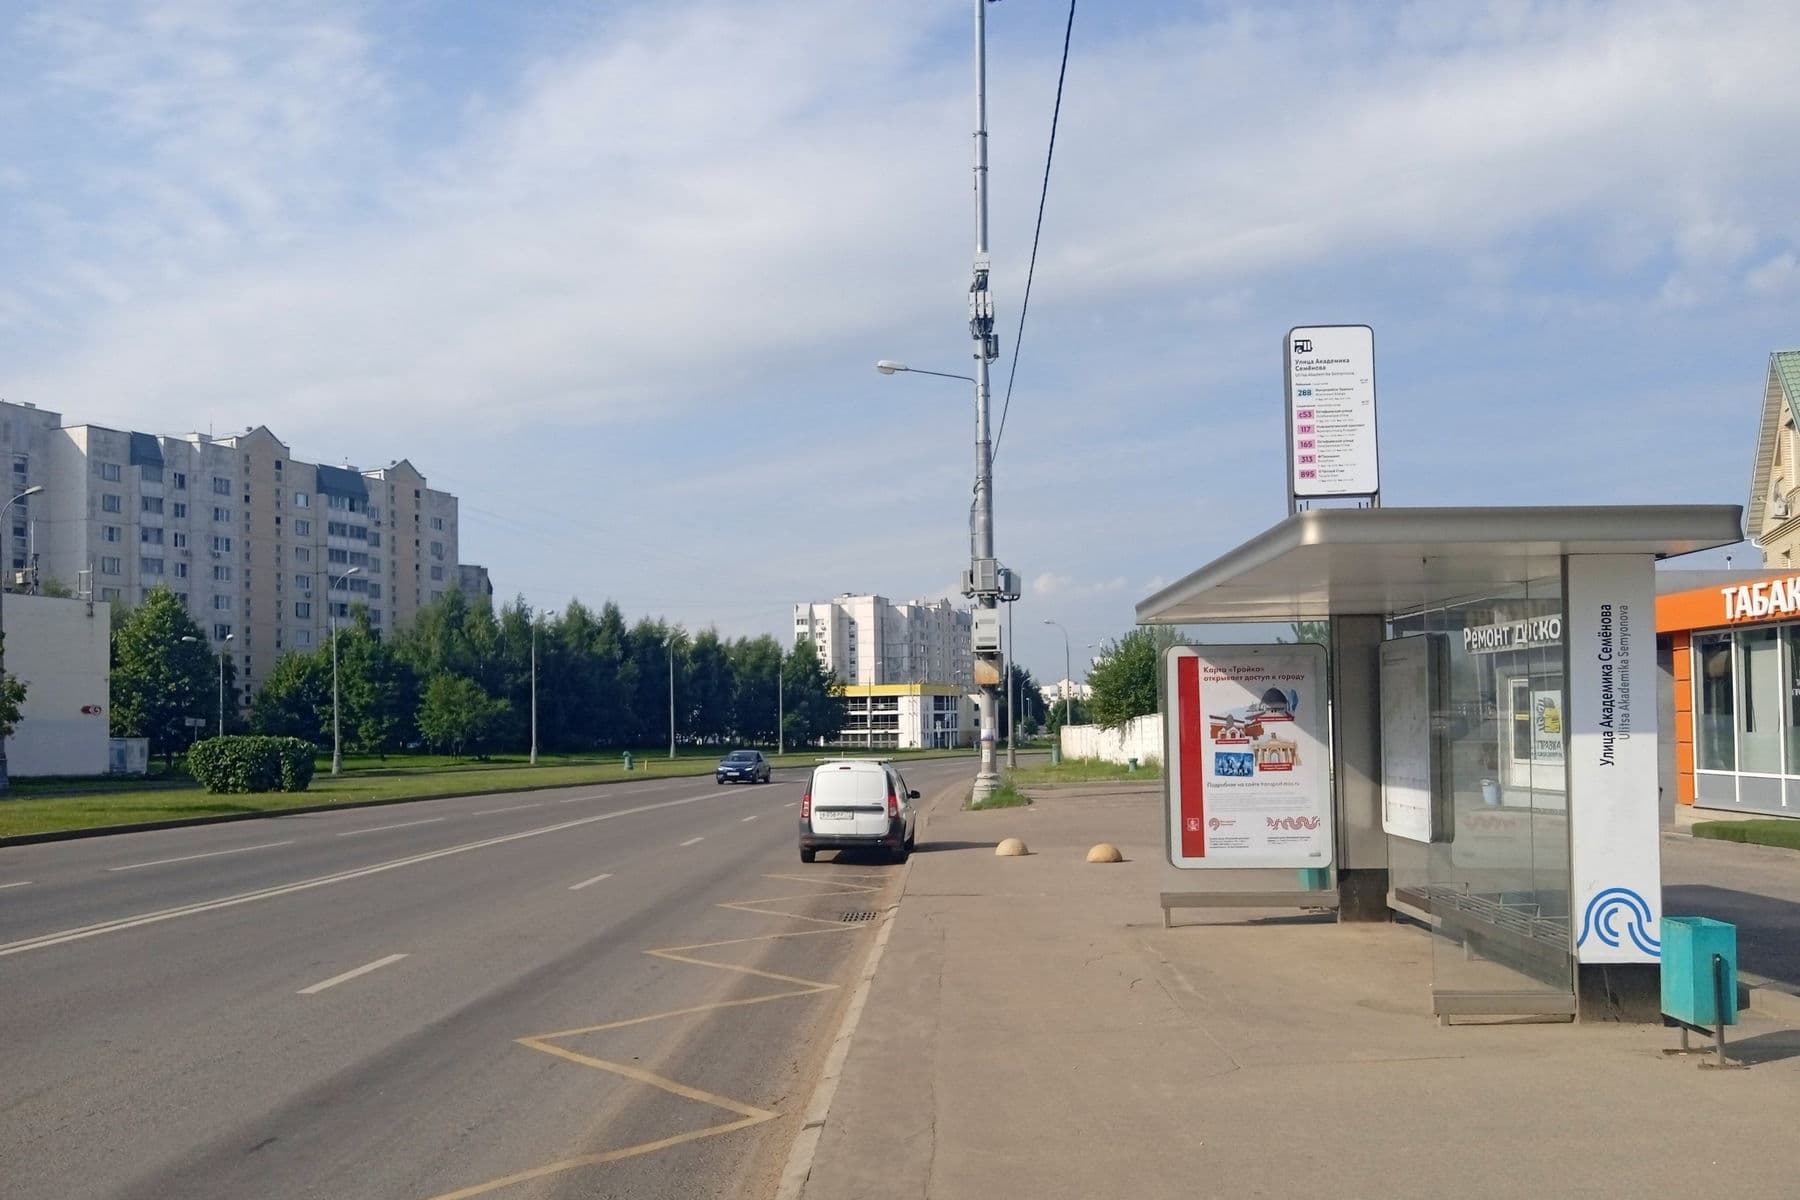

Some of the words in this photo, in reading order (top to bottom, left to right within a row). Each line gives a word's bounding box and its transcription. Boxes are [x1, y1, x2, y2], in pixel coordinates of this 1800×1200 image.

[1297, 389, 1312, 397] 288
[1597, 604, 1613, 662] Семёнова
[1617, 605, 1631, 658] Semyonova
[1203, 666, 1227, 675] Карта
[1203, 675, 1243, 683] открывает
[1244, 674, 1270, 682] доступ
[1278, 673, 1305, 681] городу
[1617, 659, 1631, 711] Akademika
[1599, 664, 1616, 728] Академика
[1617, 713, 1631, 740] Ulitsa
[1600, 731, 1616, 766] Улица
